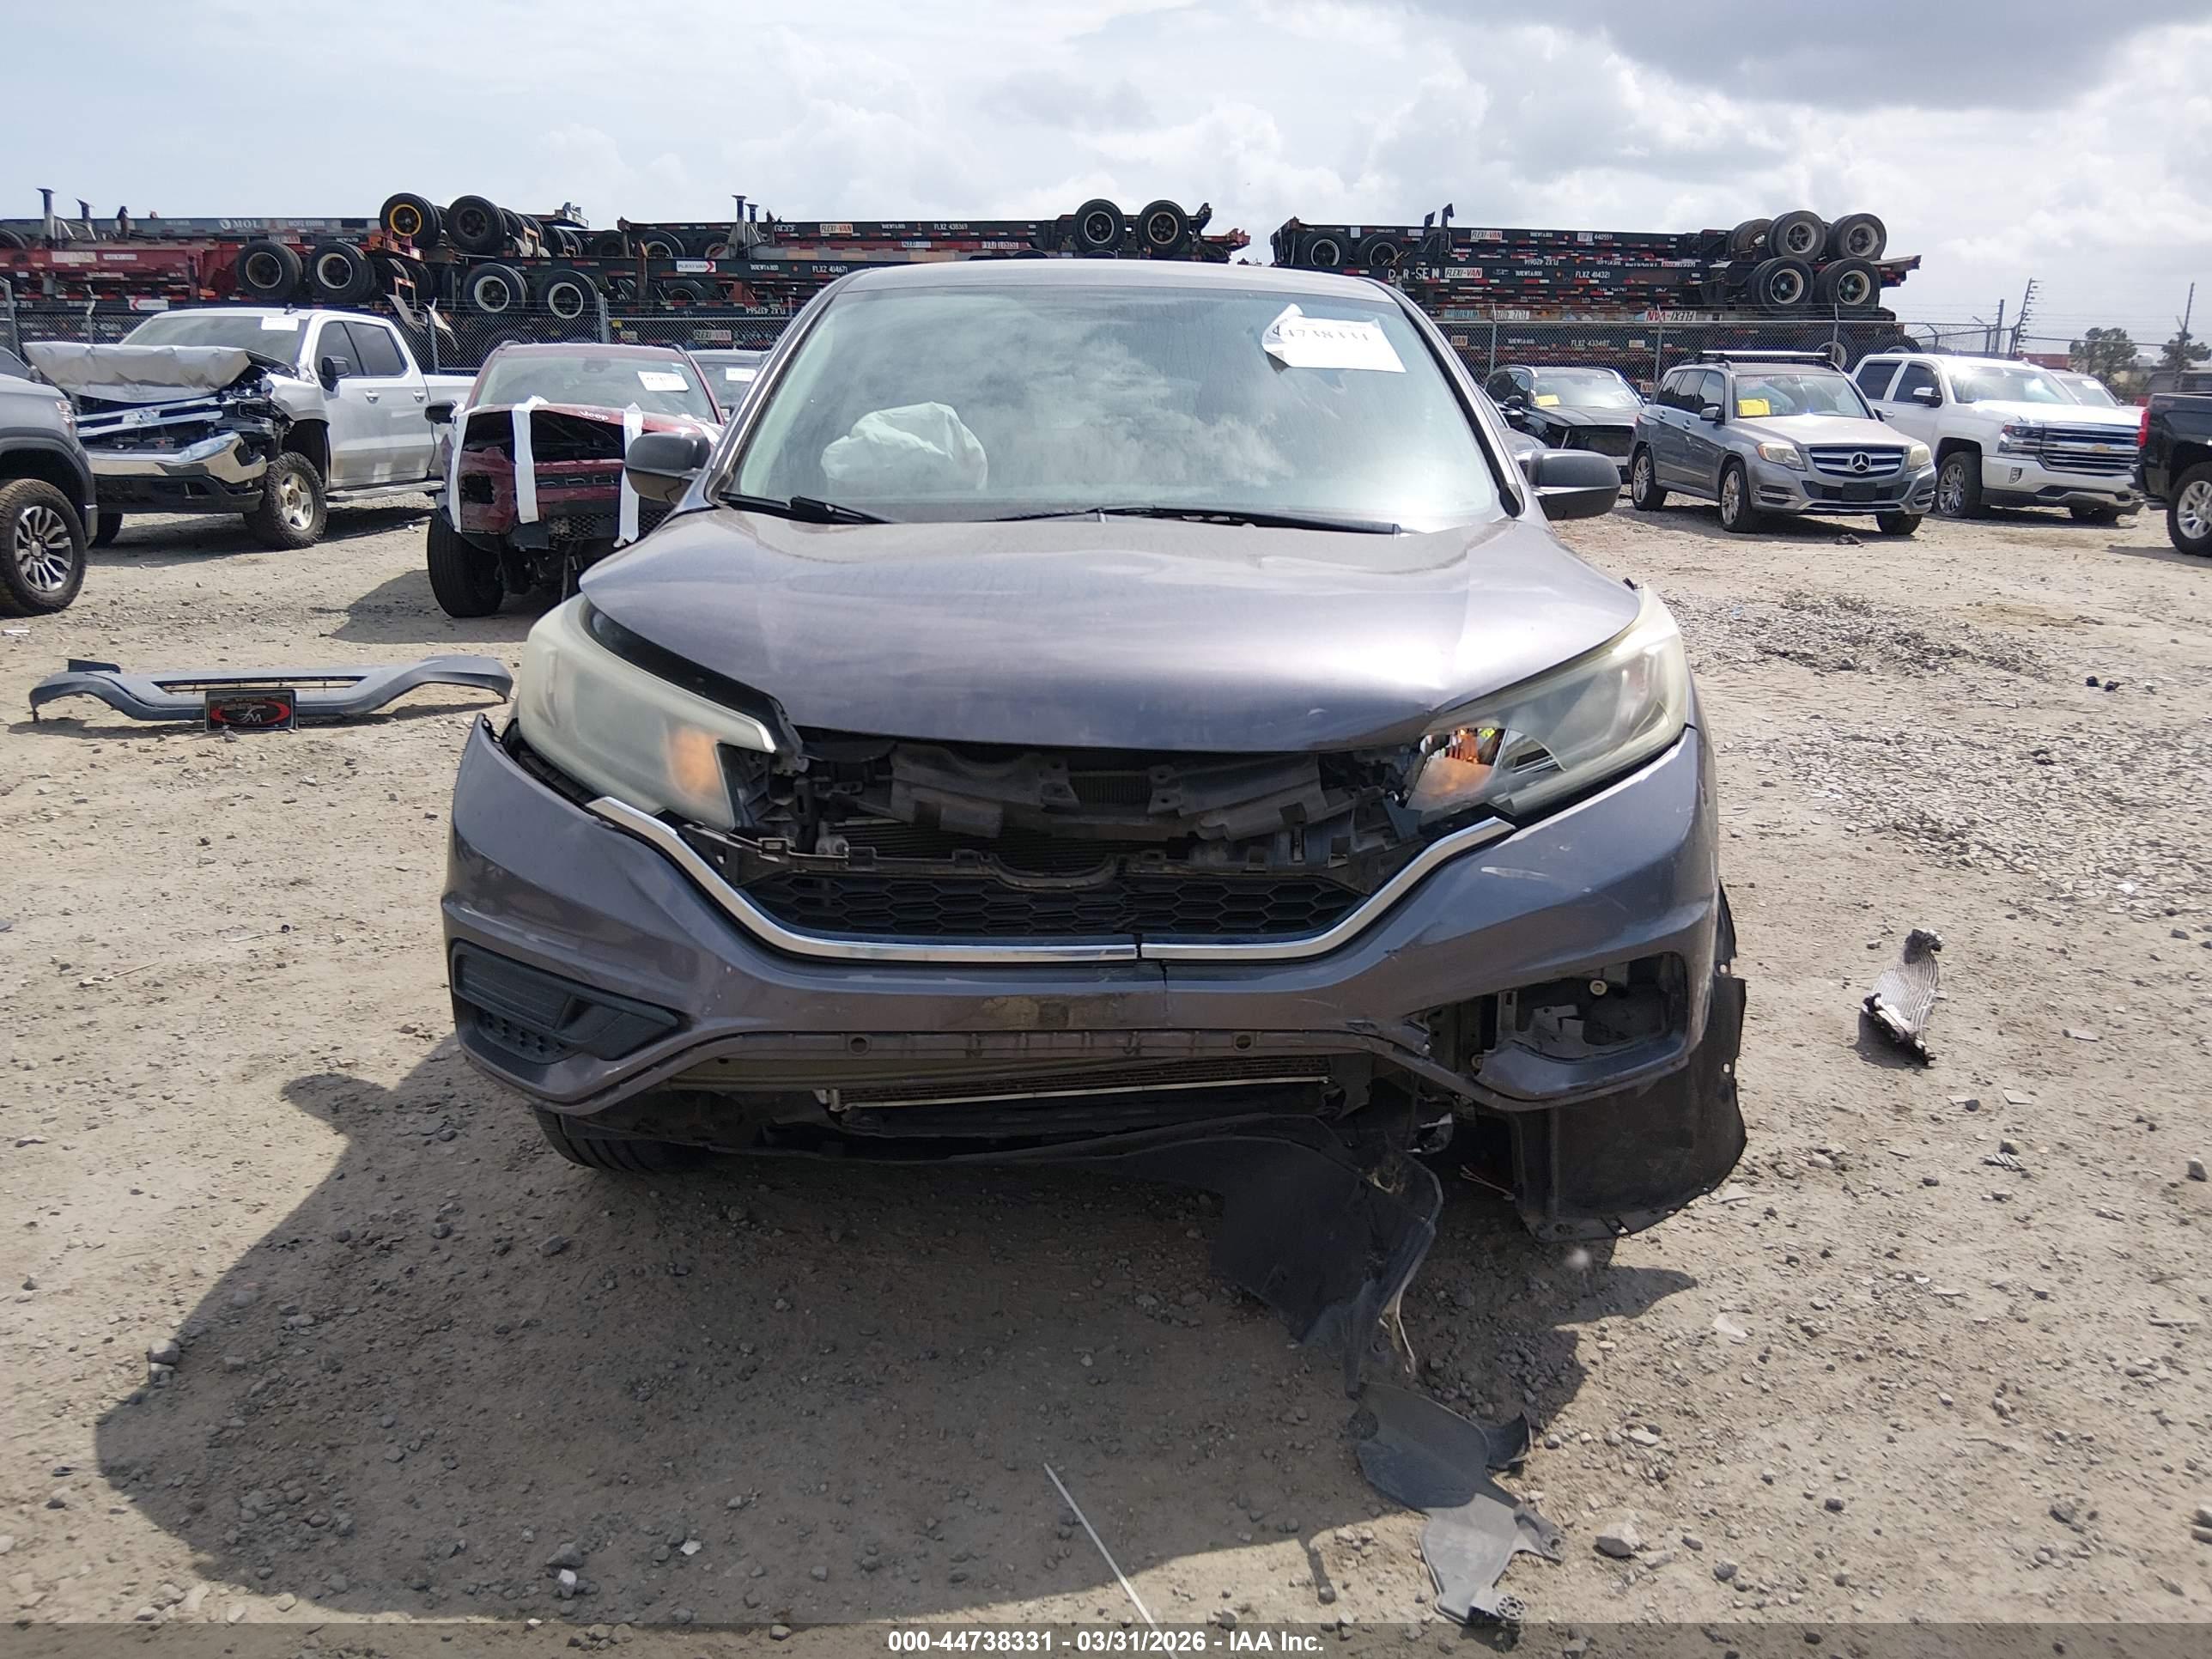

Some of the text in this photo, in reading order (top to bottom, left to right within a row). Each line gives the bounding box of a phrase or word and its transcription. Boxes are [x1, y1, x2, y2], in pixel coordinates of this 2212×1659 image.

[1446, 268, 1481, 277] FLEXI-VAN
[1647, 311, 1694, 321] FLEXI-VAN
[579, 410, 610, 421] Jeep
